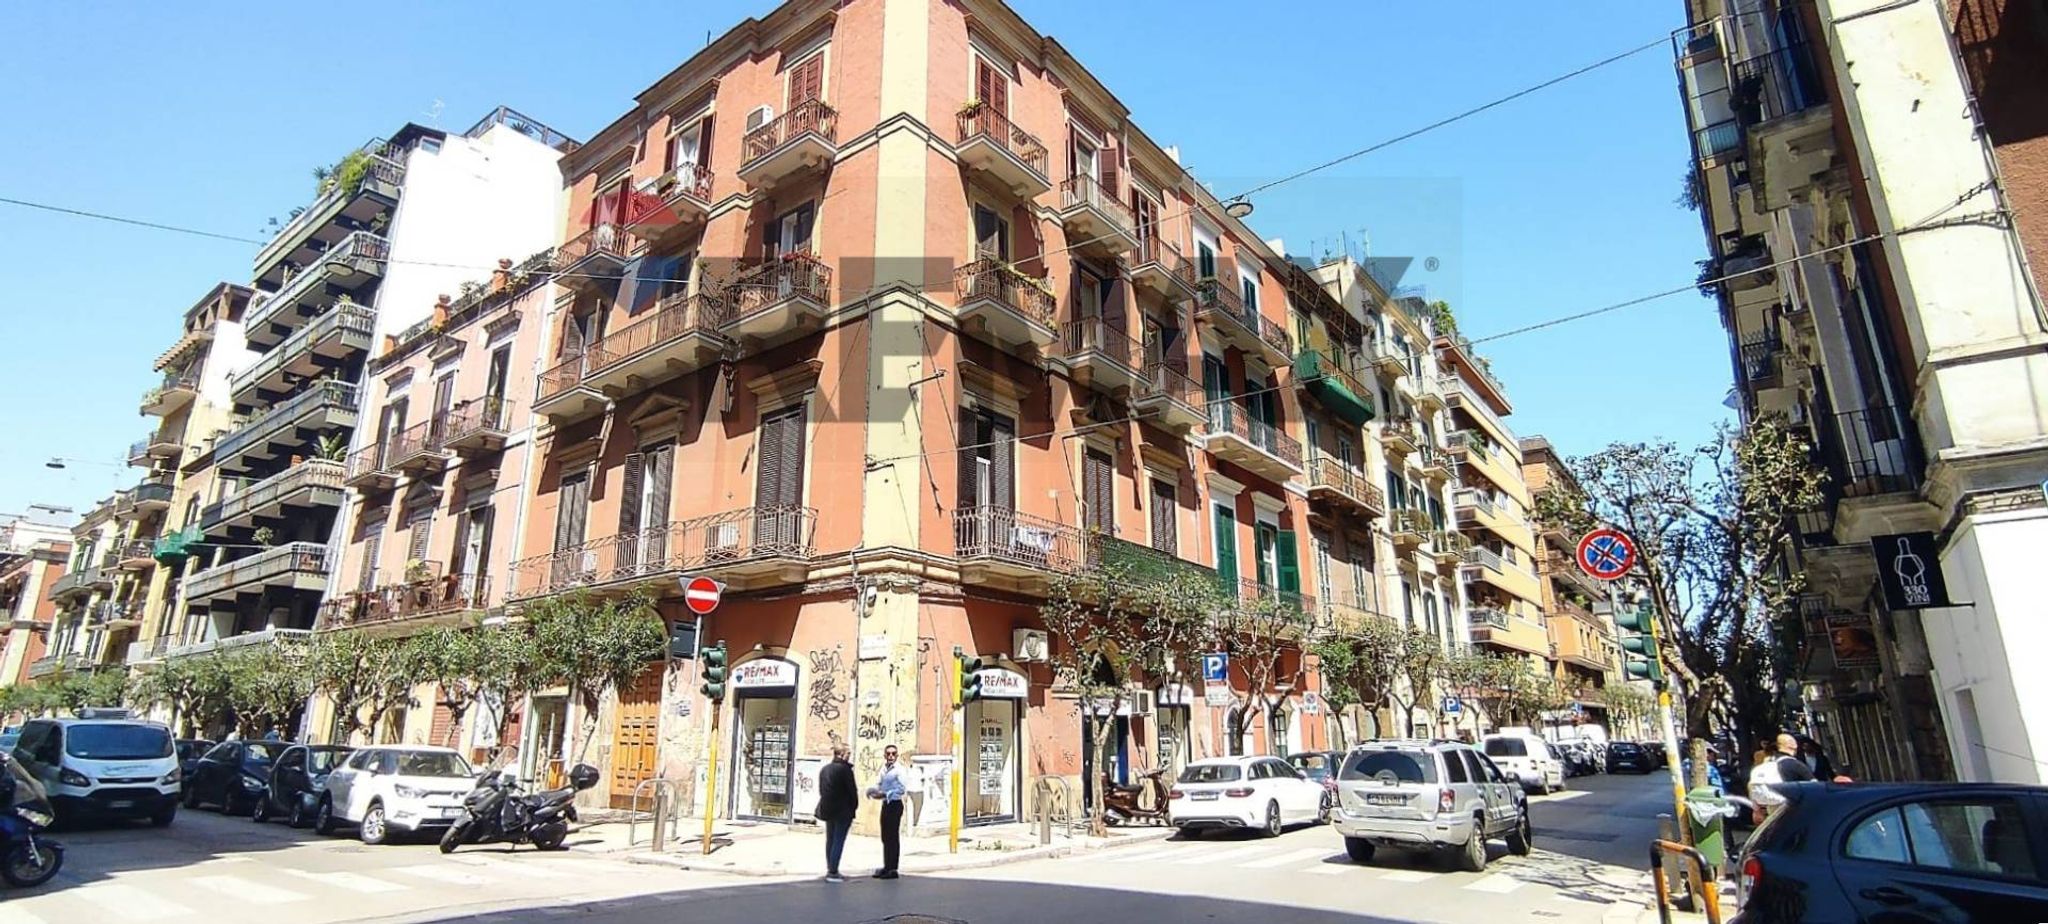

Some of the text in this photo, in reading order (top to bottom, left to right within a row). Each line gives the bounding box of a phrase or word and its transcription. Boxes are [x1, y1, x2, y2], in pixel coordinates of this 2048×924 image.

[1903, 584, 1928, 597] 330
[1904, 593, 1931, 603] VINI
[744, 665, 779, 678] RE/MAX
[1207, 656, 1223, 678] P
[984, 675, 1018, 688] RE/MAX
